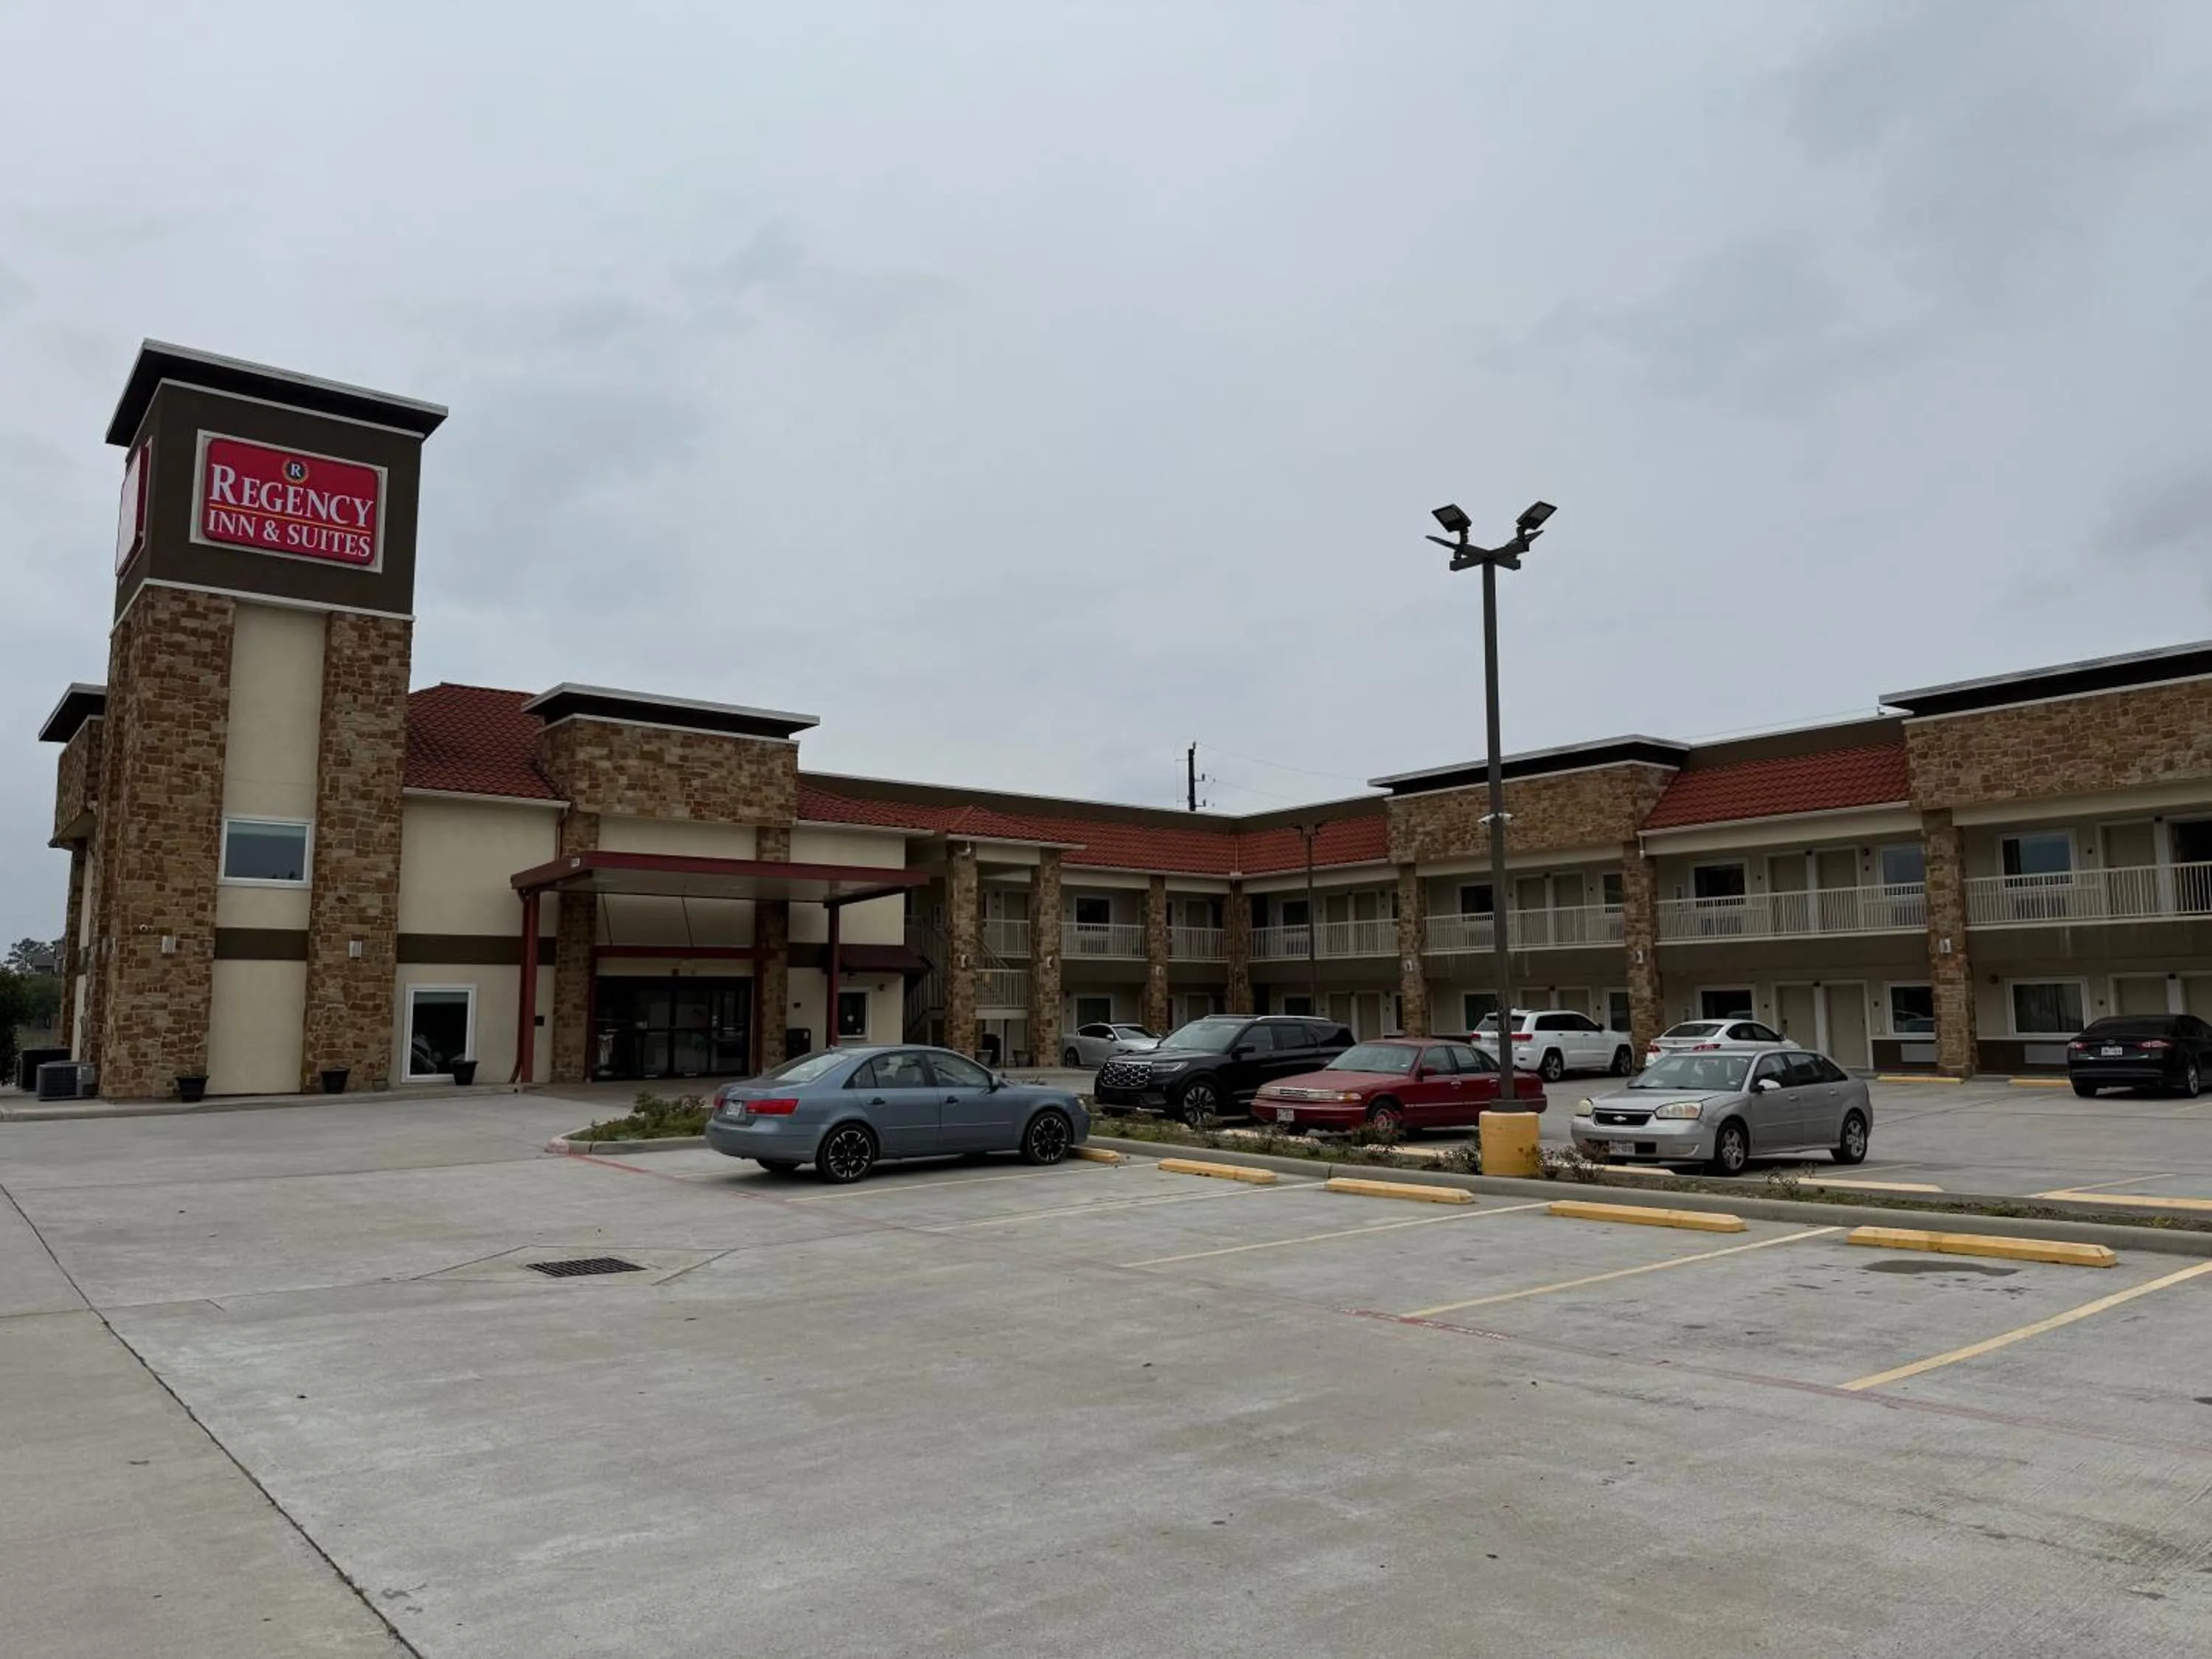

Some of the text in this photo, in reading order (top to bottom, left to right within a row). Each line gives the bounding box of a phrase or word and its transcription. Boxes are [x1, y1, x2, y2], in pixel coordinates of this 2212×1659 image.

[291, 463, 302, 478] R
[209, 464, 374, 527] REGENCY
[206, 509, 371, 557] INN & SUITES
